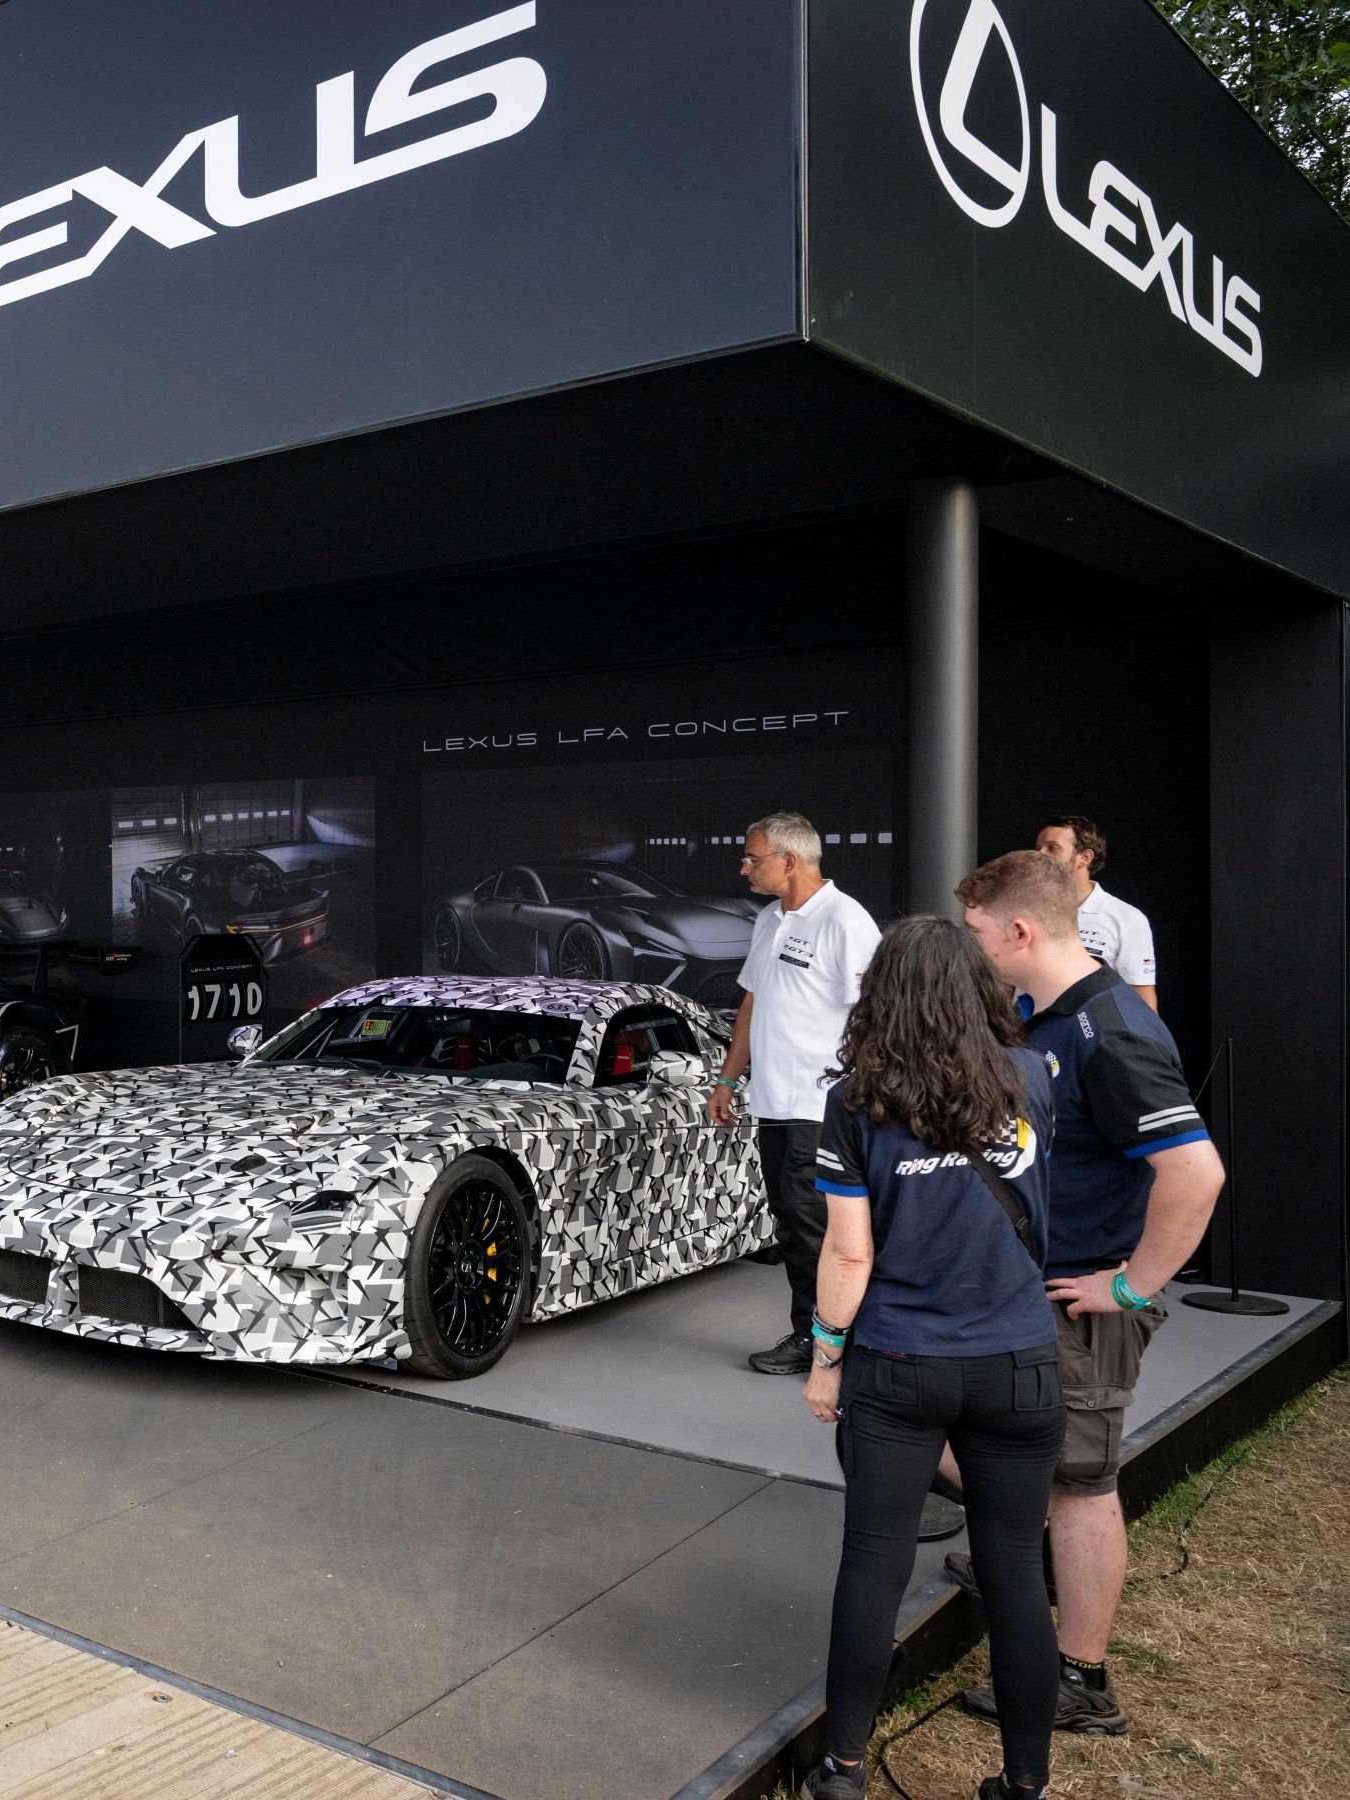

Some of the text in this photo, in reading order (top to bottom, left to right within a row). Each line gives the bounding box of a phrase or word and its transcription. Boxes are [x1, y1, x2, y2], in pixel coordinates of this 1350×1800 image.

[1041, 102, 1263, 378] LEXUS
[423, 711, 849, 752] LEXUS LFA CONCEPT
[546, 1003, 571, 1012] 635
[1077, 1011, 1094, 1039] sparco
[895, 1149, 1019, 1176] Ring Raing
[1064, 1655, 1102, 1670] WORK
